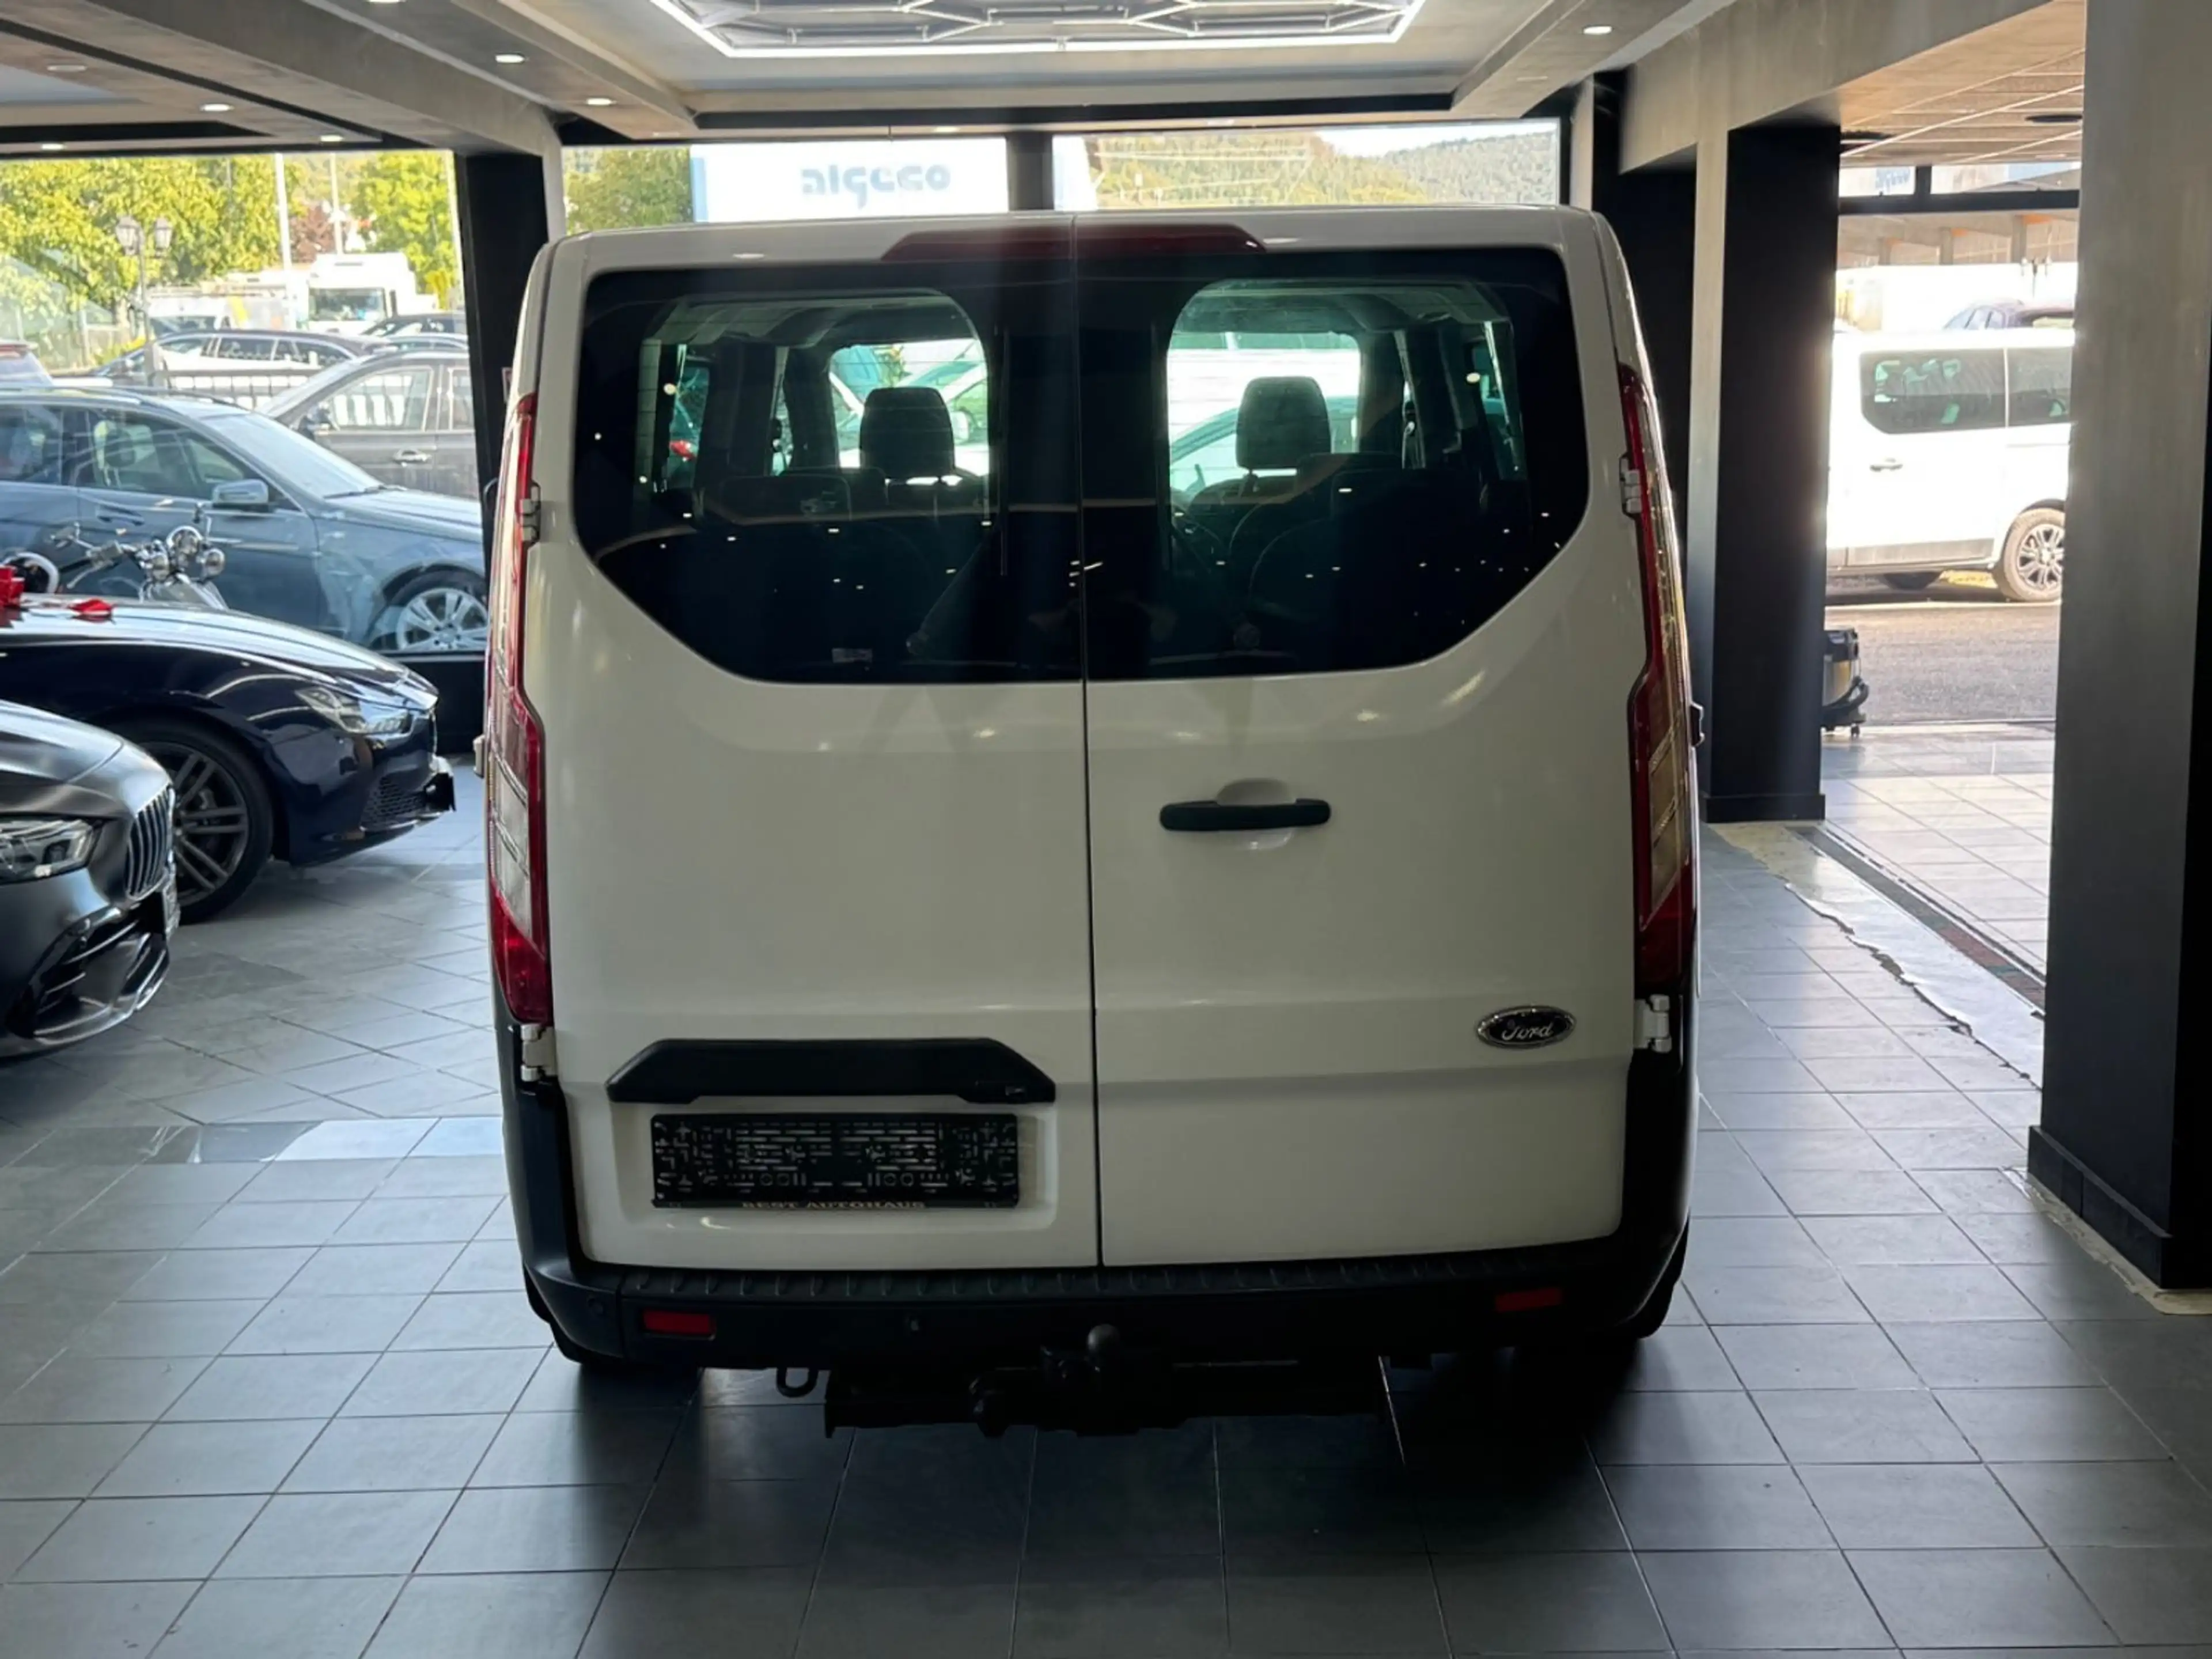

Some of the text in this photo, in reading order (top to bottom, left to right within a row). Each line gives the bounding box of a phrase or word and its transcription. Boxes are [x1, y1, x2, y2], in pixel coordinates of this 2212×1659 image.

[801, 164, 951, 209] algeco
[1501, 1021, 1554, 1041] Ford
[741, 1200, 926, 1209] BEST AUTOHAUS
